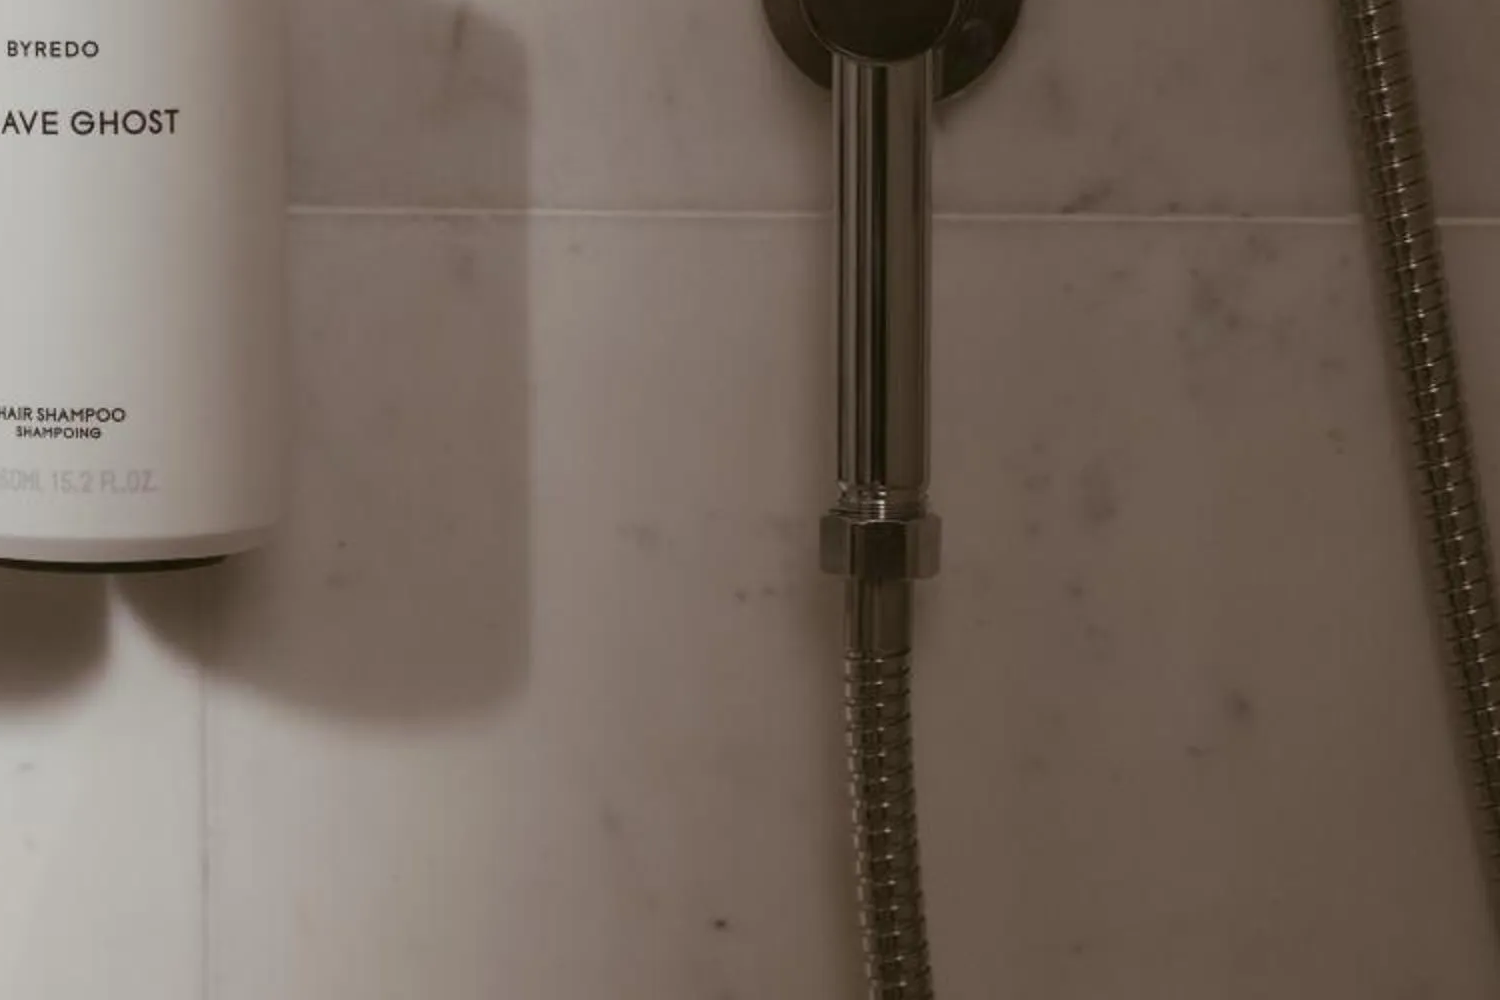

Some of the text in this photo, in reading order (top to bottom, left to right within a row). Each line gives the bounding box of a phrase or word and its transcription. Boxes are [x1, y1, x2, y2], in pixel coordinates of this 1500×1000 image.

[6, 39, 100, 59] BYREDO
[69, 108, 180, 137] GHOST
[35, 407, 127, 424] SHAMPOO
[15, 425, 103, 440] SHAMPOING
